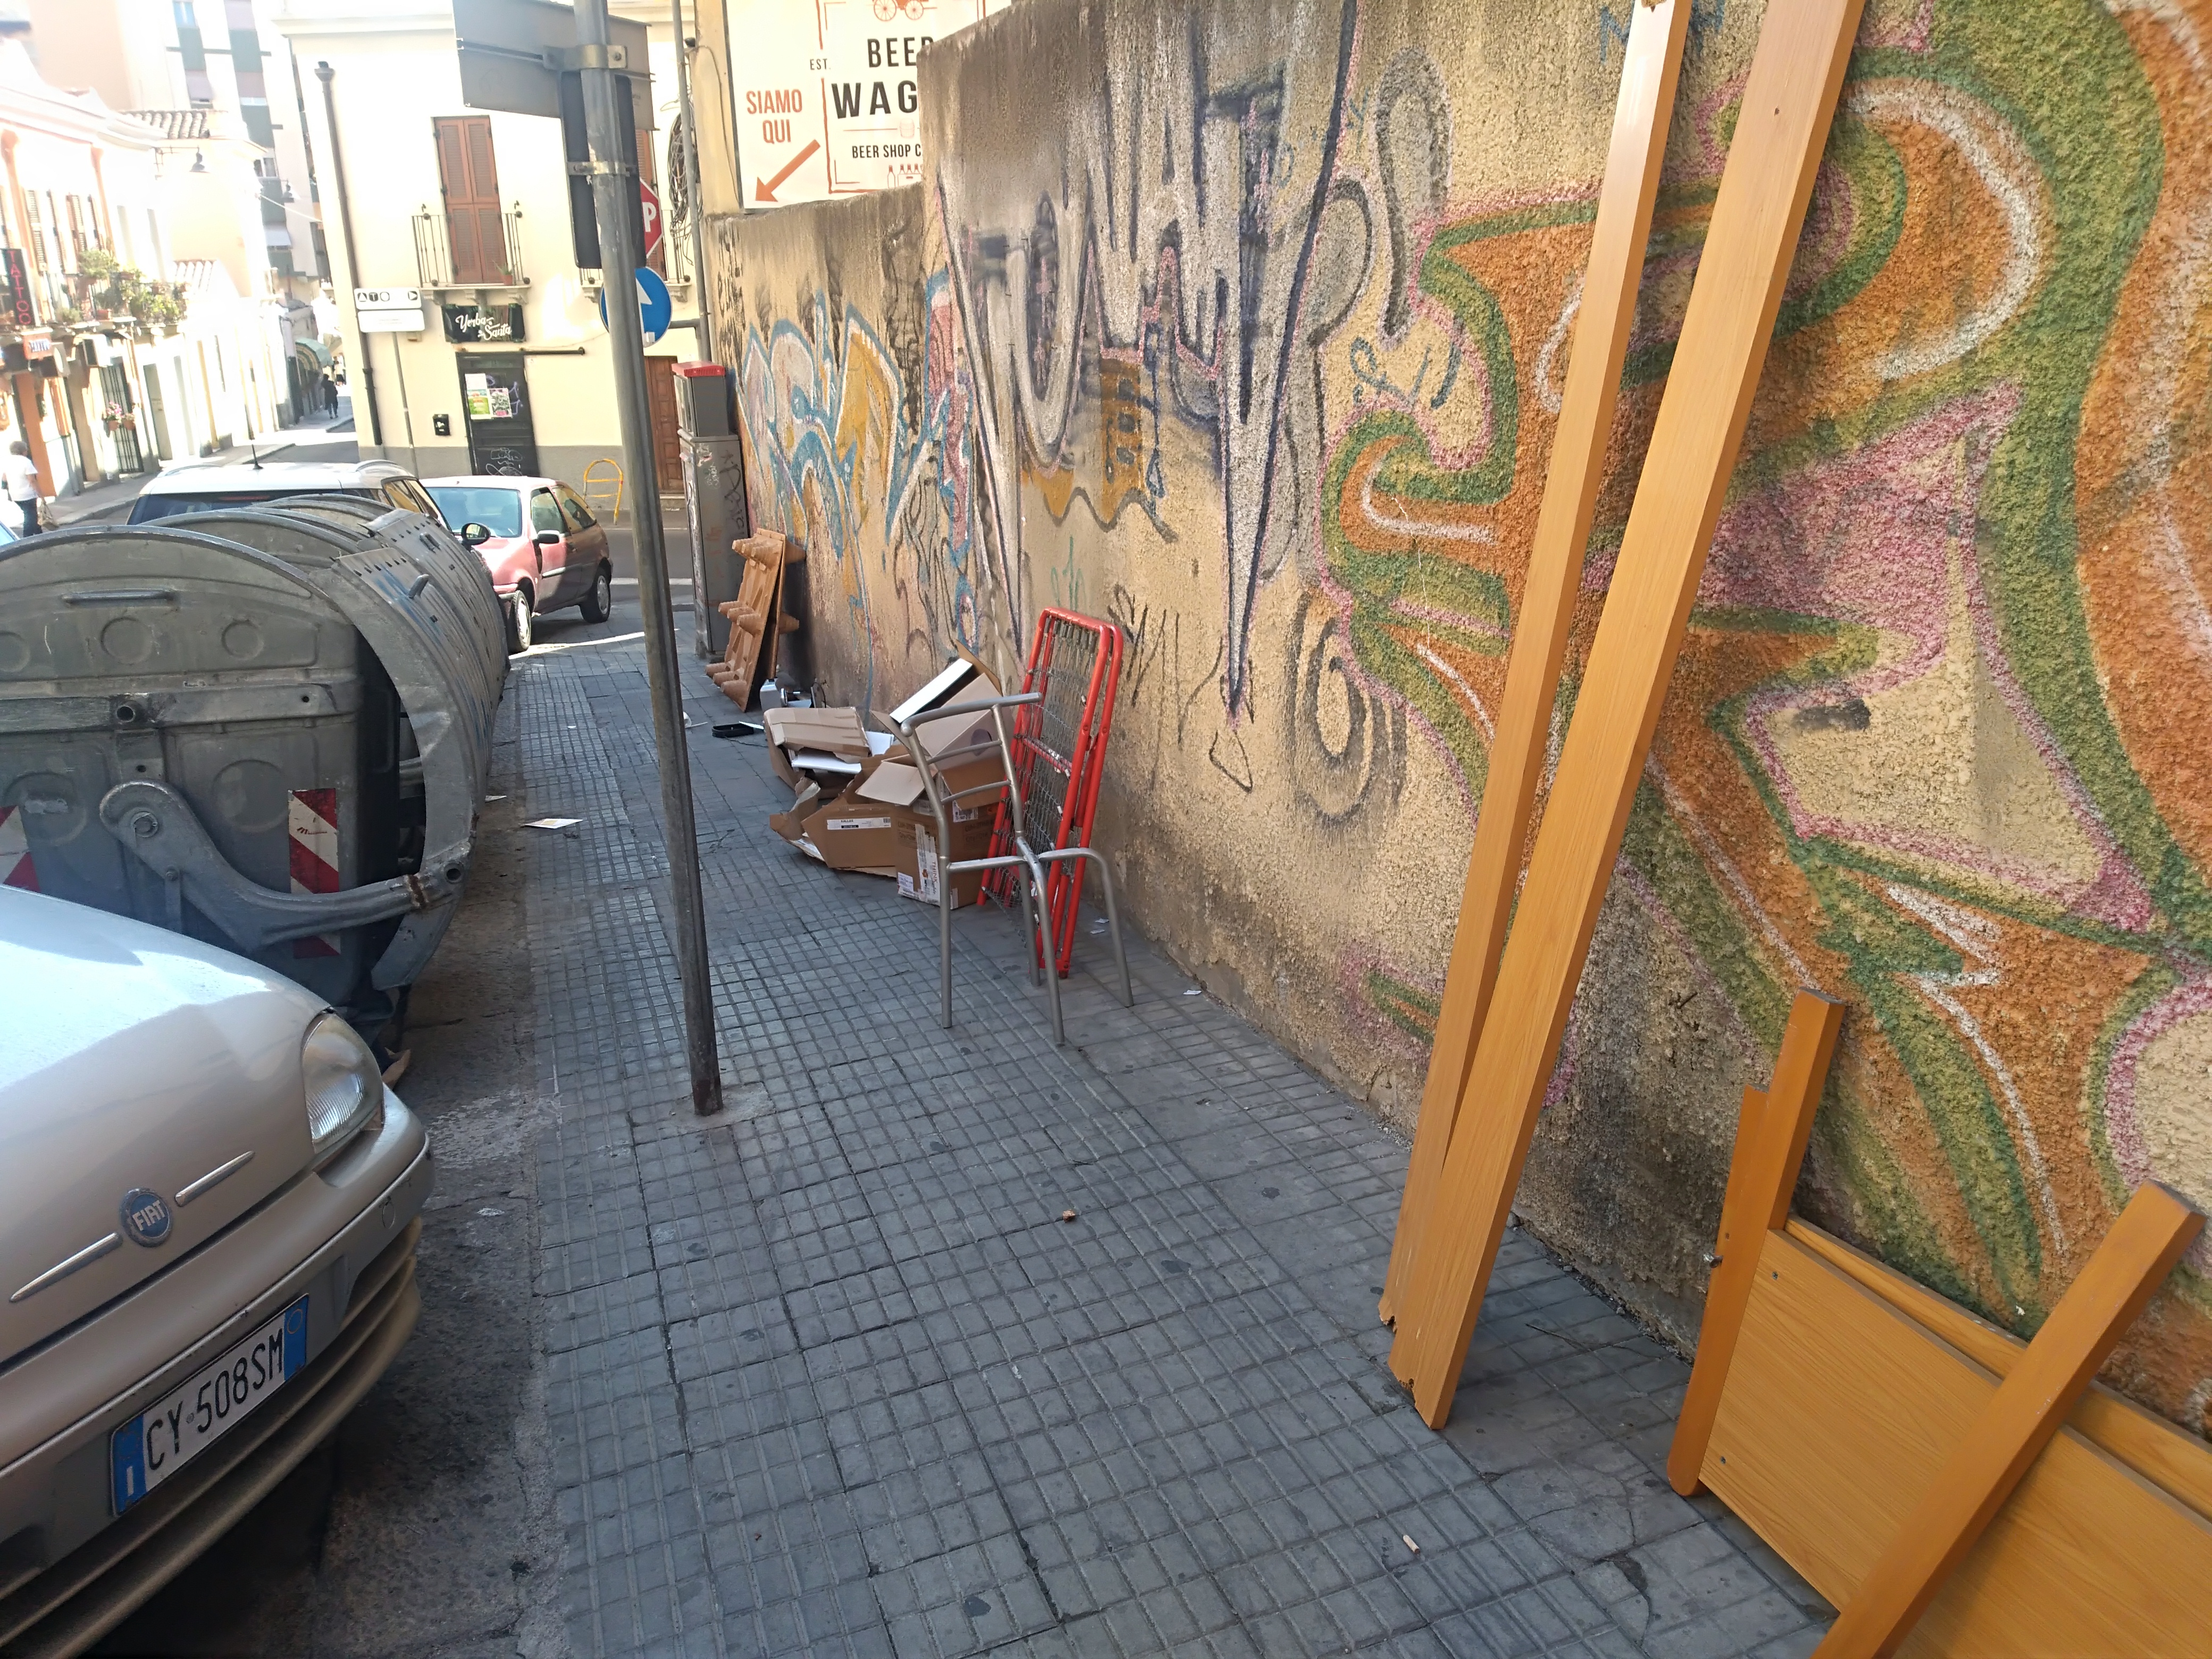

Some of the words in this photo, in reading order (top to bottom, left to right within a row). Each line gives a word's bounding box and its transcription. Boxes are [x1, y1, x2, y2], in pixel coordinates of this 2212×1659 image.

[746, 89, 803, 115] SIAMO
[762, 119, 792, 145] QUI
[852, 145, 879, 158] BEER
[883, 144, 911, 158] SHOP
[7, 250, 32, 325] TATTOO
[455, 312, 487, 333] Yerba
[477, 323, 512, 340] Santa
[132, 1200, 165, 1233] FIAT
